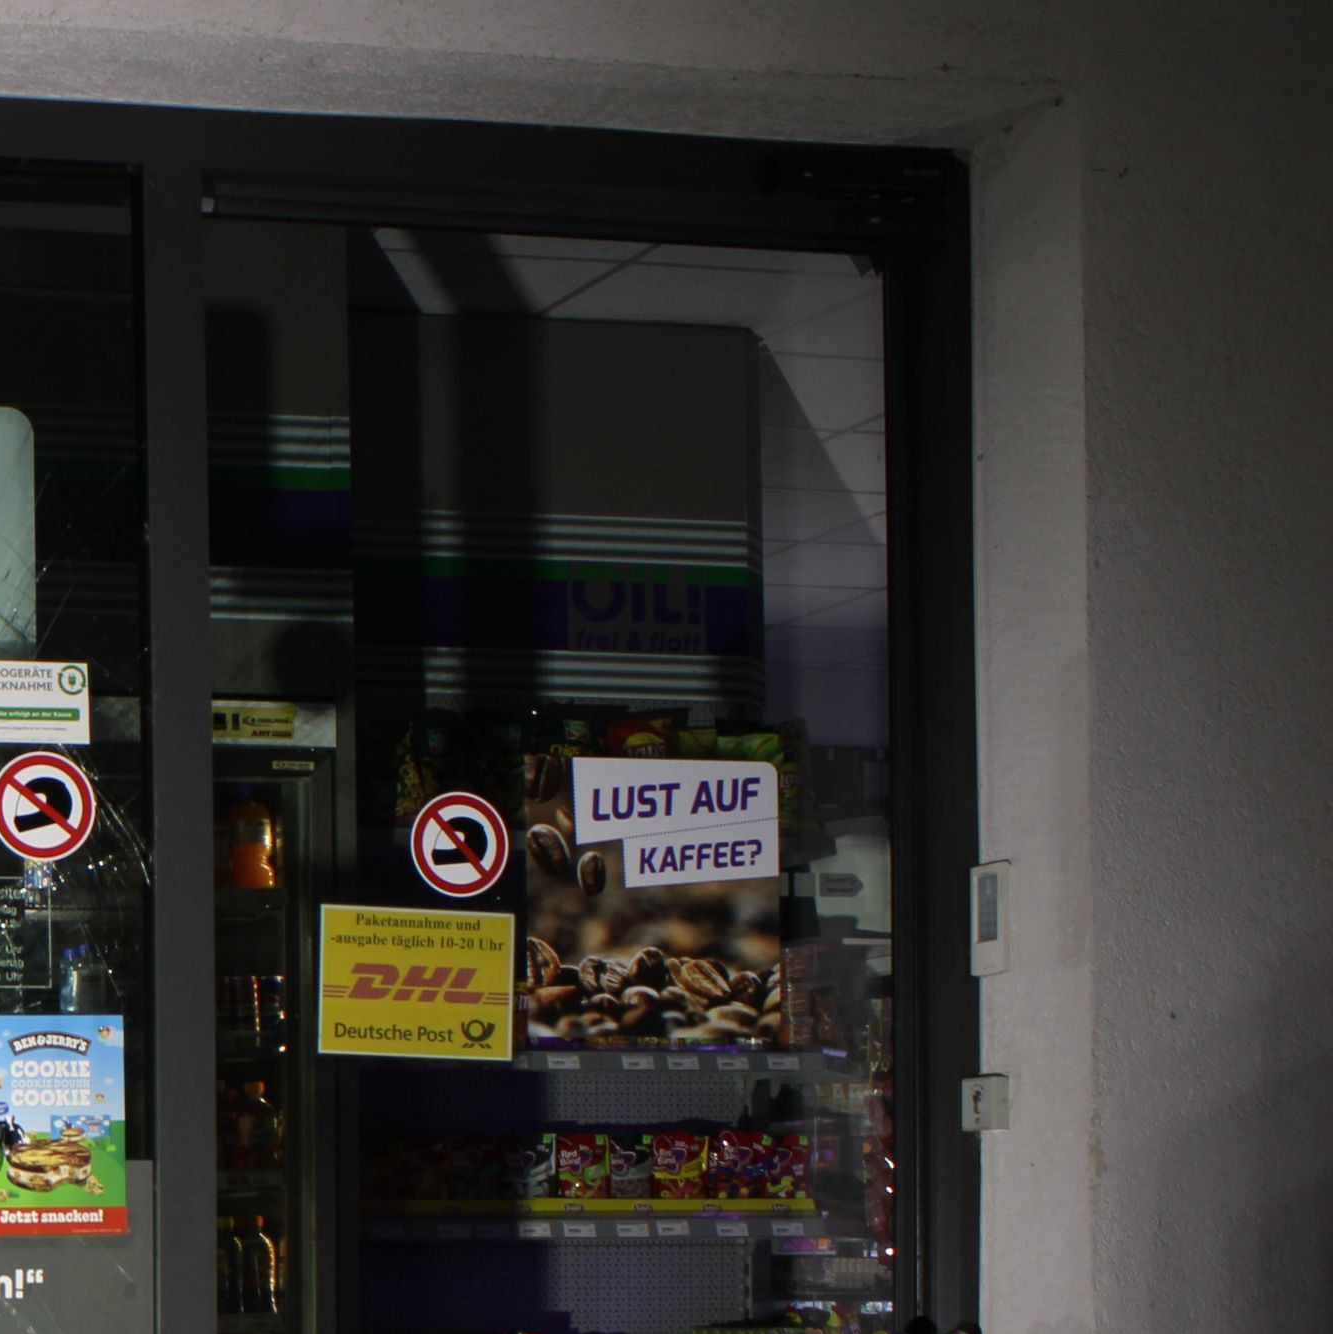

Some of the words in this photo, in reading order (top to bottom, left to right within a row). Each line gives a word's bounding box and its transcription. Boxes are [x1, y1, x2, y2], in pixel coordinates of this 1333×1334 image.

[591, 782, 680, 821] LUST
[690, 777, 761, 814] AUF
[639, 838, 762, 874] KAFFEE?
[356, 913, 452, 931] Paketannahme
[456, 920, 481, 931] und
[330, 932, 388, 947] -ausgabe
[391, 934, 434, 949] täglich
[439, 937, 474, 949] 10-20
[479, 939, 505, 951] Uhr
[348, 962, 485, 1004] DHL
[334, 1022, 412, 1041] Deutsche
[417, 1026, 454, 1043] Post
[10, 1060, 91, 1078] COOKIE
[12, 1079, 52, 1088] COOKIE
[54, 1079, 90, 1088] DOUGH
[11, 1089, 91, 1106] COOKIE
[0, 1210, 39, 1224] Jetzt
[41, 1209, 104, 1223] snacken!
